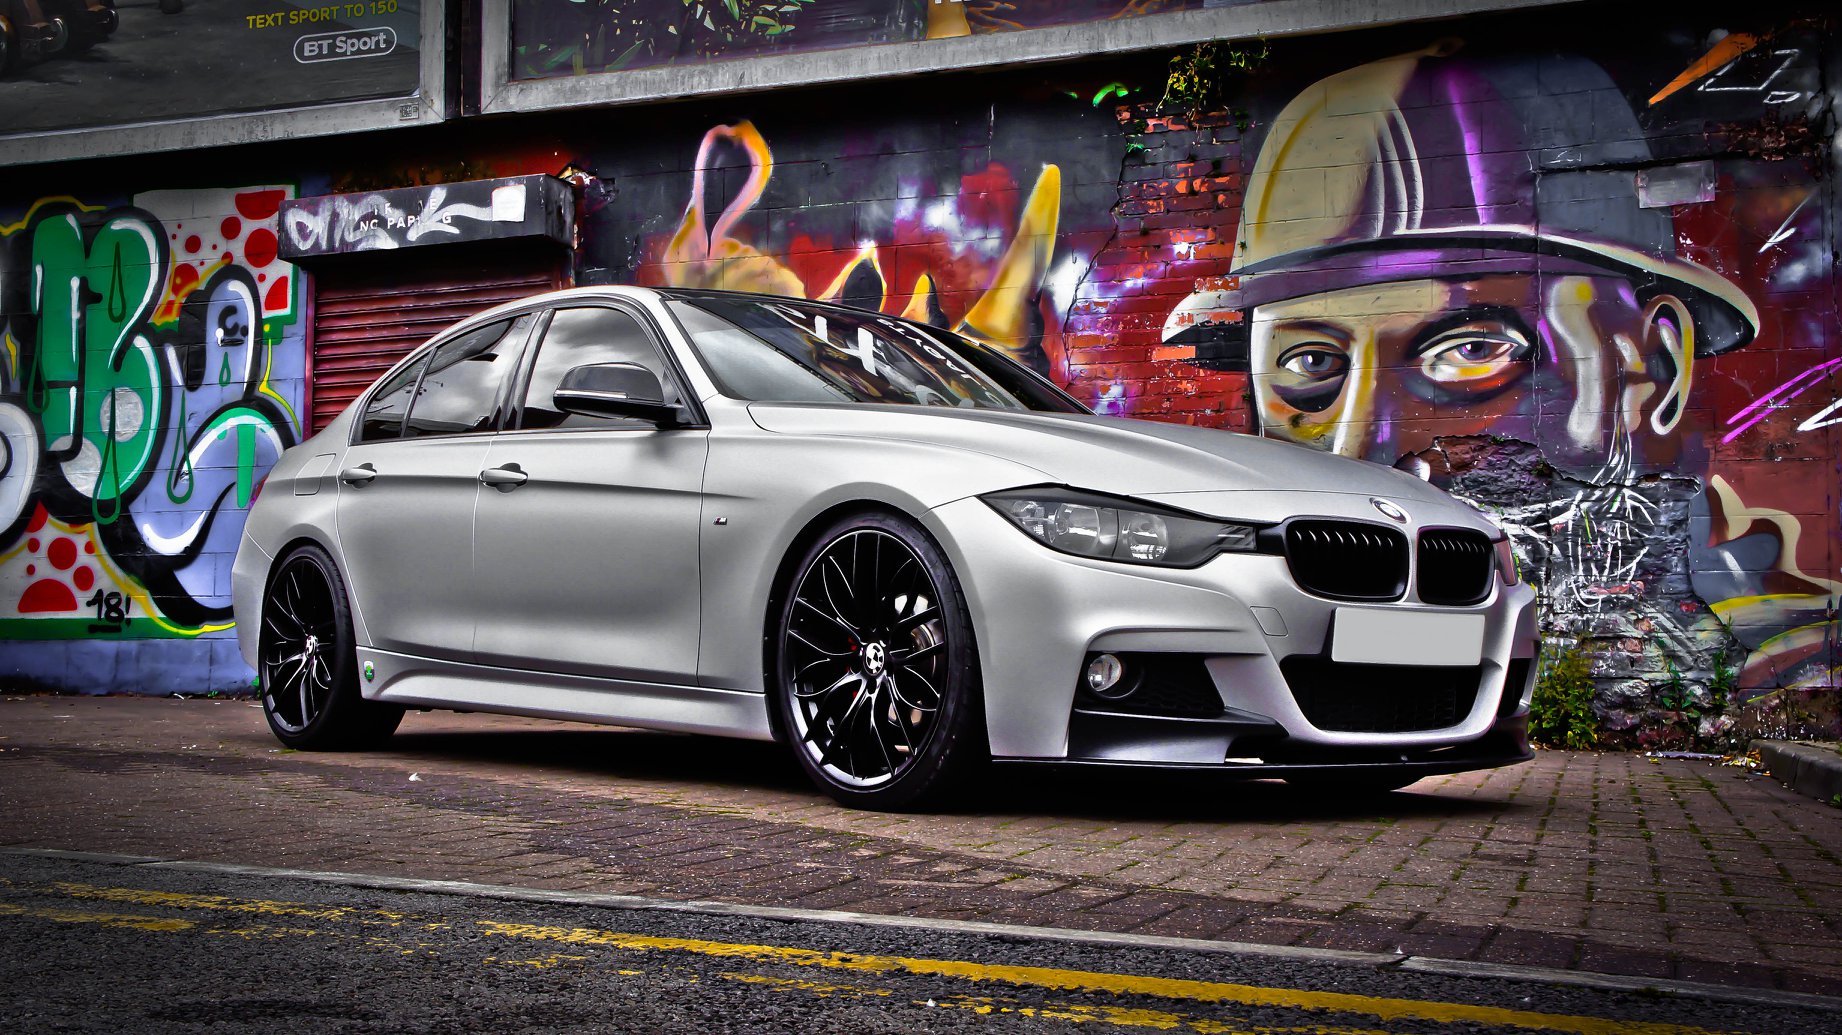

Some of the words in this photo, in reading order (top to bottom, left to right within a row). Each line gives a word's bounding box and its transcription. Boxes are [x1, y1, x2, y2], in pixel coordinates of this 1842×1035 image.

[246, 12, 285, 29] TEXT
[289, 6, 340, 24] SPORT
[344, 3, 365, 18] TO
[370, 0, 398, 15] 150
[304, 39, 333, 56] BT
[335, 32, 387, 55] Sport
